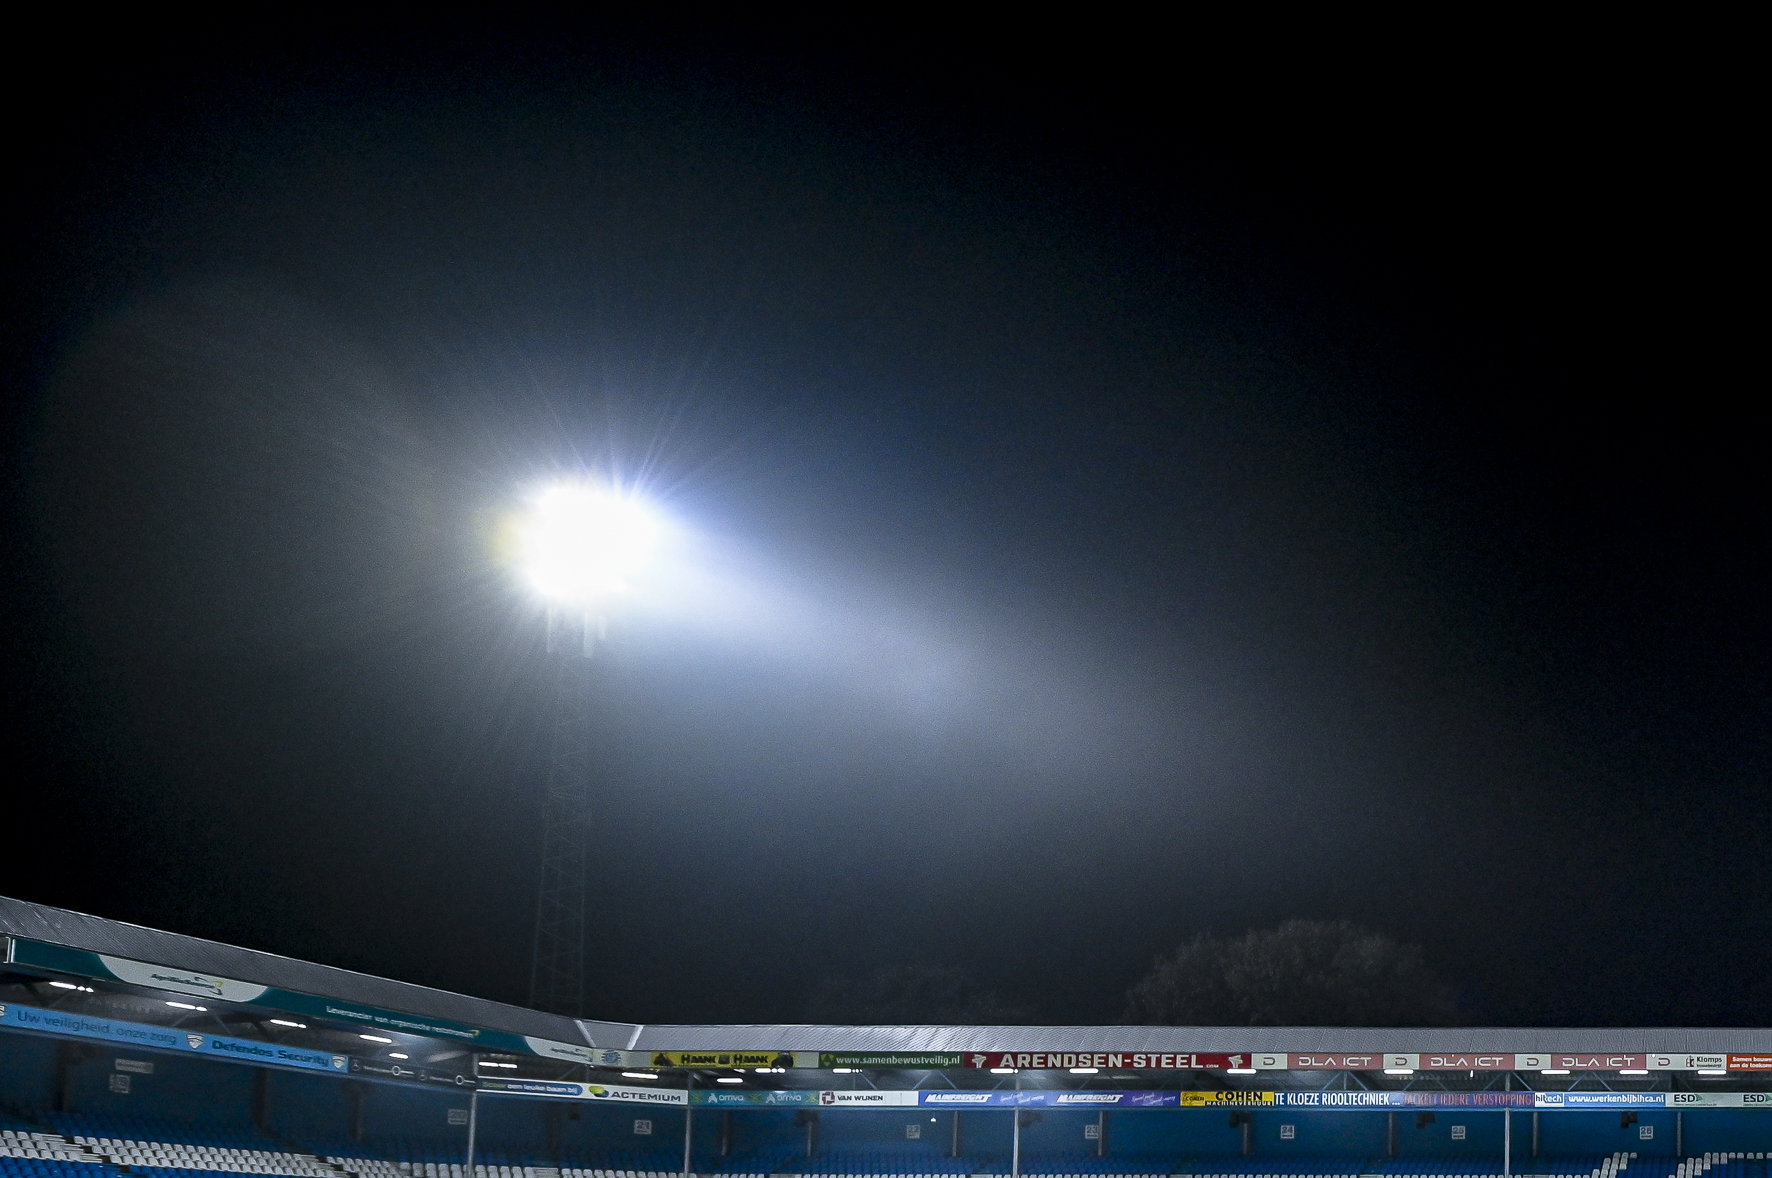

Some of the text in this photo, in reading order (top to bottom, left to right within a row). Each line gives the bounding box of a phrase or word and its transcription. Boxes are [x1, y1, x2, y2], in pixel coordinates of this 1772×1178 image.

[17, 1010, 40, 1024] Uw
[211, 1039, 330, 1068] Defendos Security
[836, 1055, 960, 1067] www.samenbewustveilig.nl
[1000, 1053, 1204, 1069] ARENDSEN-STEEL
[1298, 1056, 1372, 1067] DLA ICT
[1430, 1056, 1504, 1067] DLA ICT
[1561, 1056, 1636, 1067] DLA ICT
[1696, 1056, 1723, 1064] Klomps
[611, 1090, 682, 1102] ACTEMIUM
[924, 1093, 993, 1103] MAINFREIGHT
[1056, 1094, 1123, 1103] MAINFREIGHT
[1215, 1091, 1263, 1102] COHEN
[1275, 1092, 1390, 1106] TE KLOEZE RIOOLTECHNIEK
[1673, 1094, 1696, 1103] ESD
[1743, 1094, 1765, 1103] ESD
